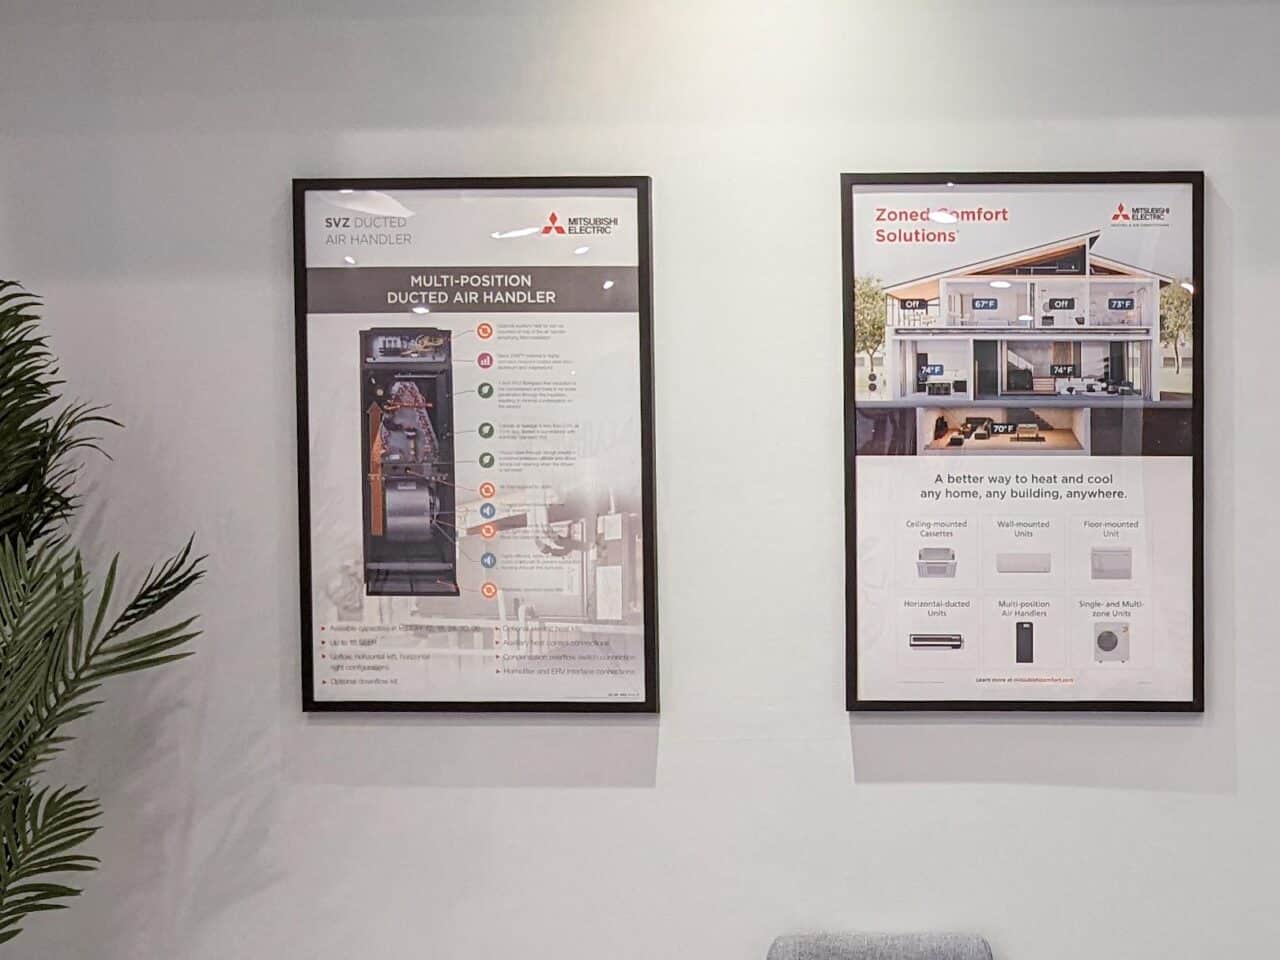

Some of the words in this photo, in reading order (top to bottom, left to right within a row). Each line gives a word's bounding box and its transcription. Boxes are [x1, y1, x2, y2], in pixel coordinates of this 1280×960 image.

[875, 208, 930, 221] Zoned
[935, 208, 1009, 221] omfort
[325, 217, 350, 228] SVZ
[354, 217, 407, 228] DUCTED
[568, 217, 618, 226] MITSUBISHI
[568, 226, 611, 234] ELECTRIC
[326, 234, 346, 245] AIR
[350, 234, 412, 245] HANDLER
[410, 275, 532, 287] MULTI-POSITION
[387, 291, 448, 304] DUCTED
[453, 291, 479, 304] AIR
[483, 291, 556, 304] HANDLER
[905, 300, 920, 309] Off
[1054, 300, 1069, 309] Off
[934, 474, 944, 484] A
[947, 474, 984, 484] better
[987, 476, 1012, 486] way
[1015, 475, 1028, 484] to
[1031, 474, 1058, 484] heat
[1061, 474, 1084, 484] and
[1087, 474, 1113, 484] cool
[920, 491, 940, 500] any
[945, 488, 982, 500] home,
[985, 491, 1006, 500] any
[1010, 488, 1063, 500] building,
[1066, 488, 1128, 500] anywhere.
[905, 520, 968, 530] Ceiling-mounted
[997, 520, 1050, 529] Wall-mounted
[1083, 520, 1139, 529] Floor-mounted
[919, 530, 953, 538] Cassettes
[1014, 530, 1033, 538] Units
[1103, 530, 1119, 538] Unit
[903, 600, 970, 608] Horizontal-ducted
[998, 600, 1050, 609] Multi-position
[1106, 600, 1120, 608] and
[927, 609, 947, 617] Units
[1001, 609, 1013, 617] Air
[1014, 609, 1047, 617] Handlers
[1112, 609, 1131, 617] Units
